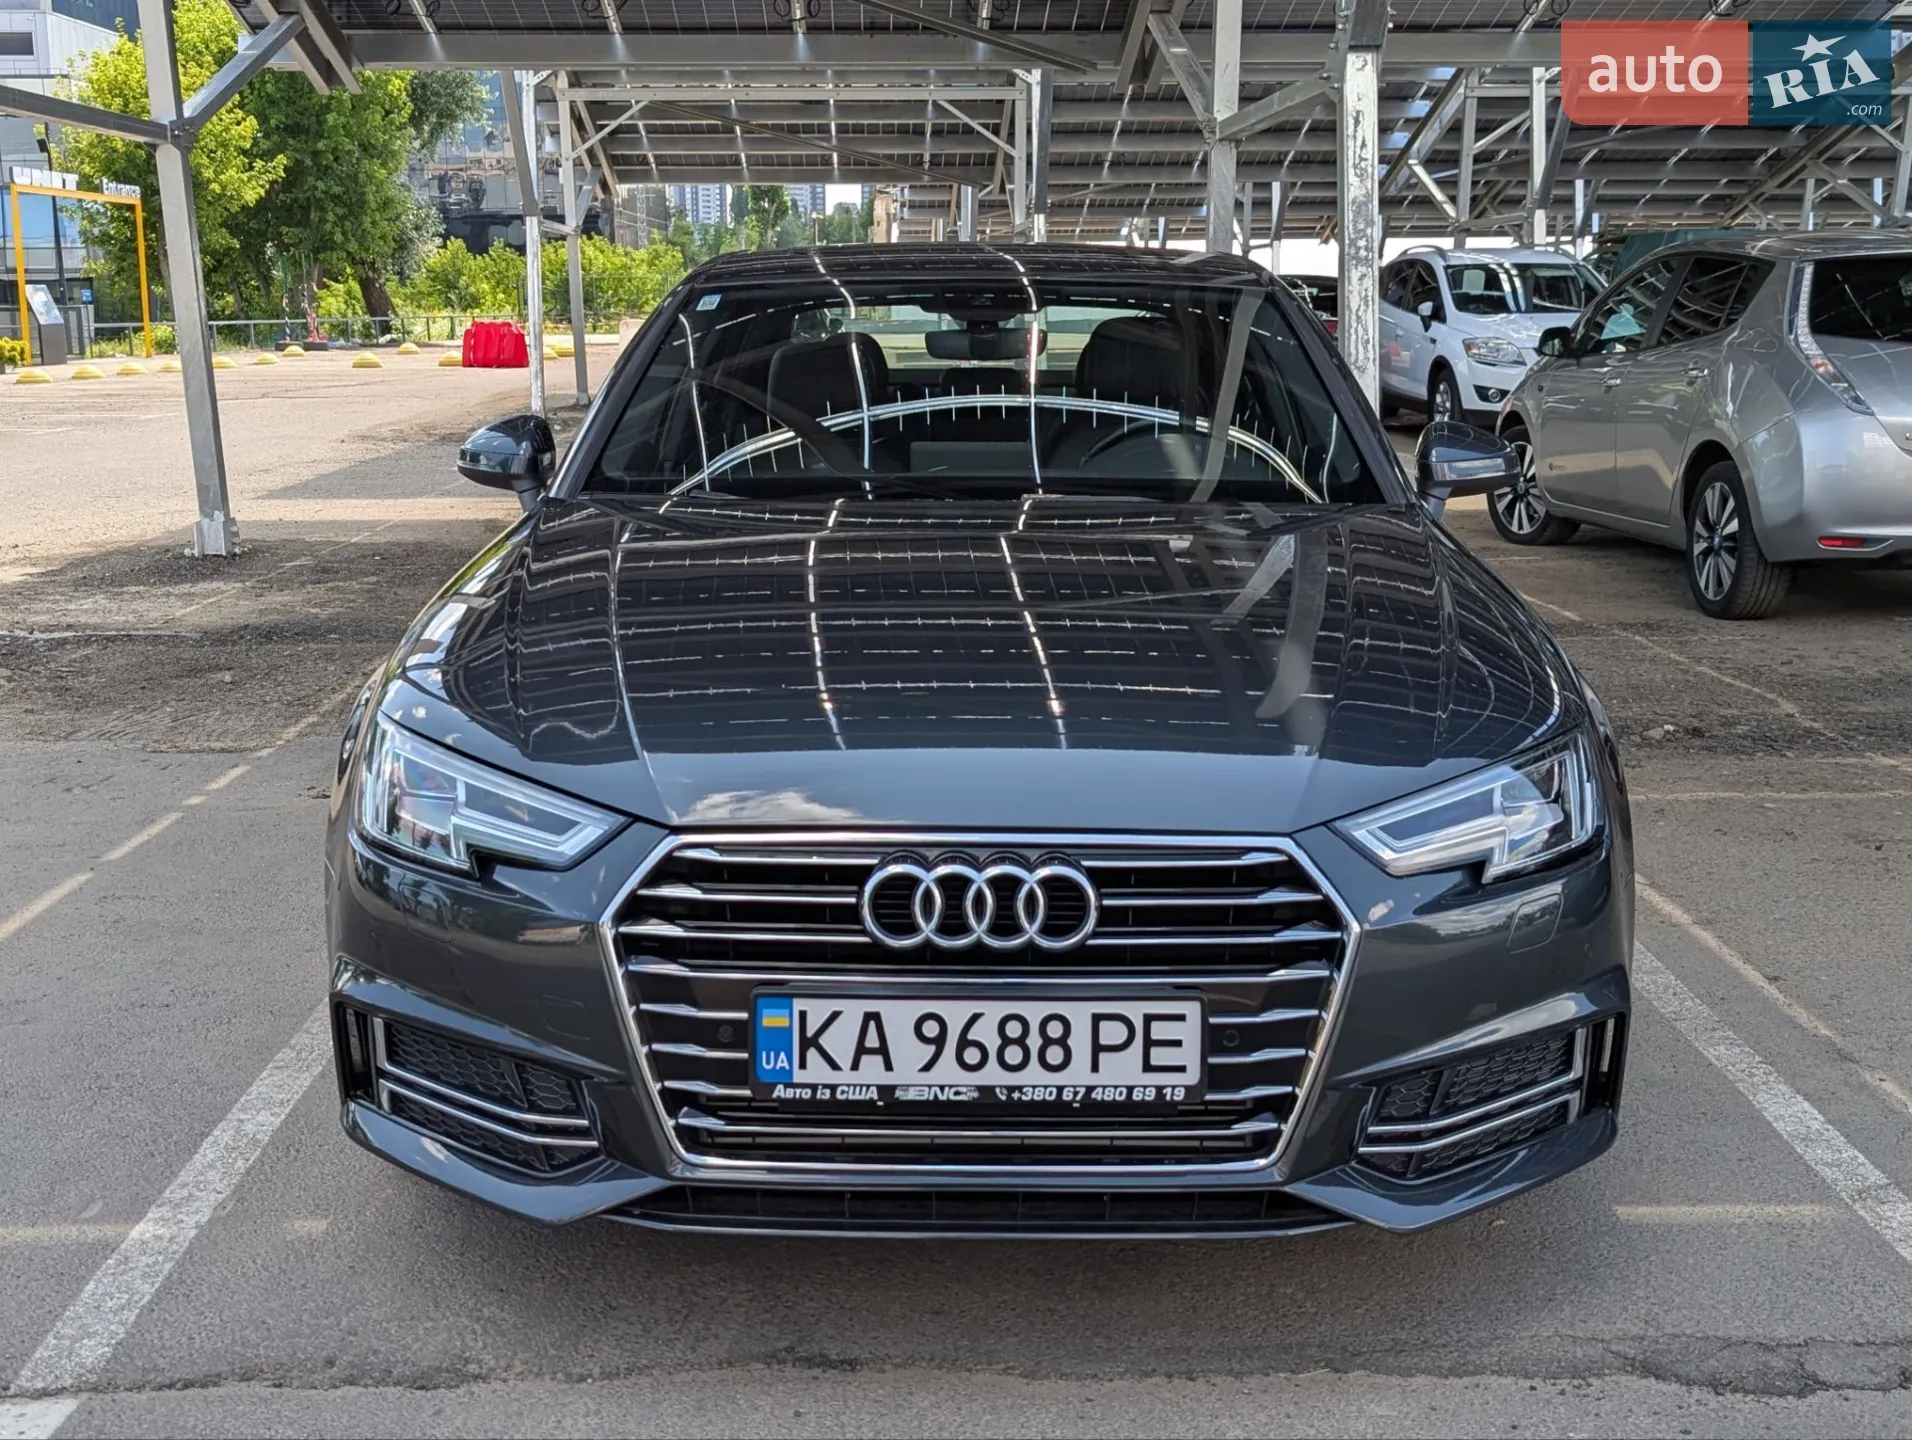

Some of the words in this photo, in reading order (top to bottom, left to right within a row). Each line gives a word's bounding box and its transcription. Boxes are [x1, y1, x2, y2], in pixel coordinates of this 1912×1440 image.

[102, 177, 141, 198] Entrance
[798, 1009, 894, 1072] KA
[913, 1012, 1073, 1073] 9688
[1090, 1012, 1187, 1073] PE
[762, 1051, 790, 1070] UA
[836, 1086, 879, 1100] США
[1012, 1086, 1057, 1101] +380
[1062, 1086, 1086, 1101] 67
[1091, 1086, 1127, 1101] 480
[1132, 1086, 1156, 1101] 69
[1162, 1086, 1186, 1101] 19
